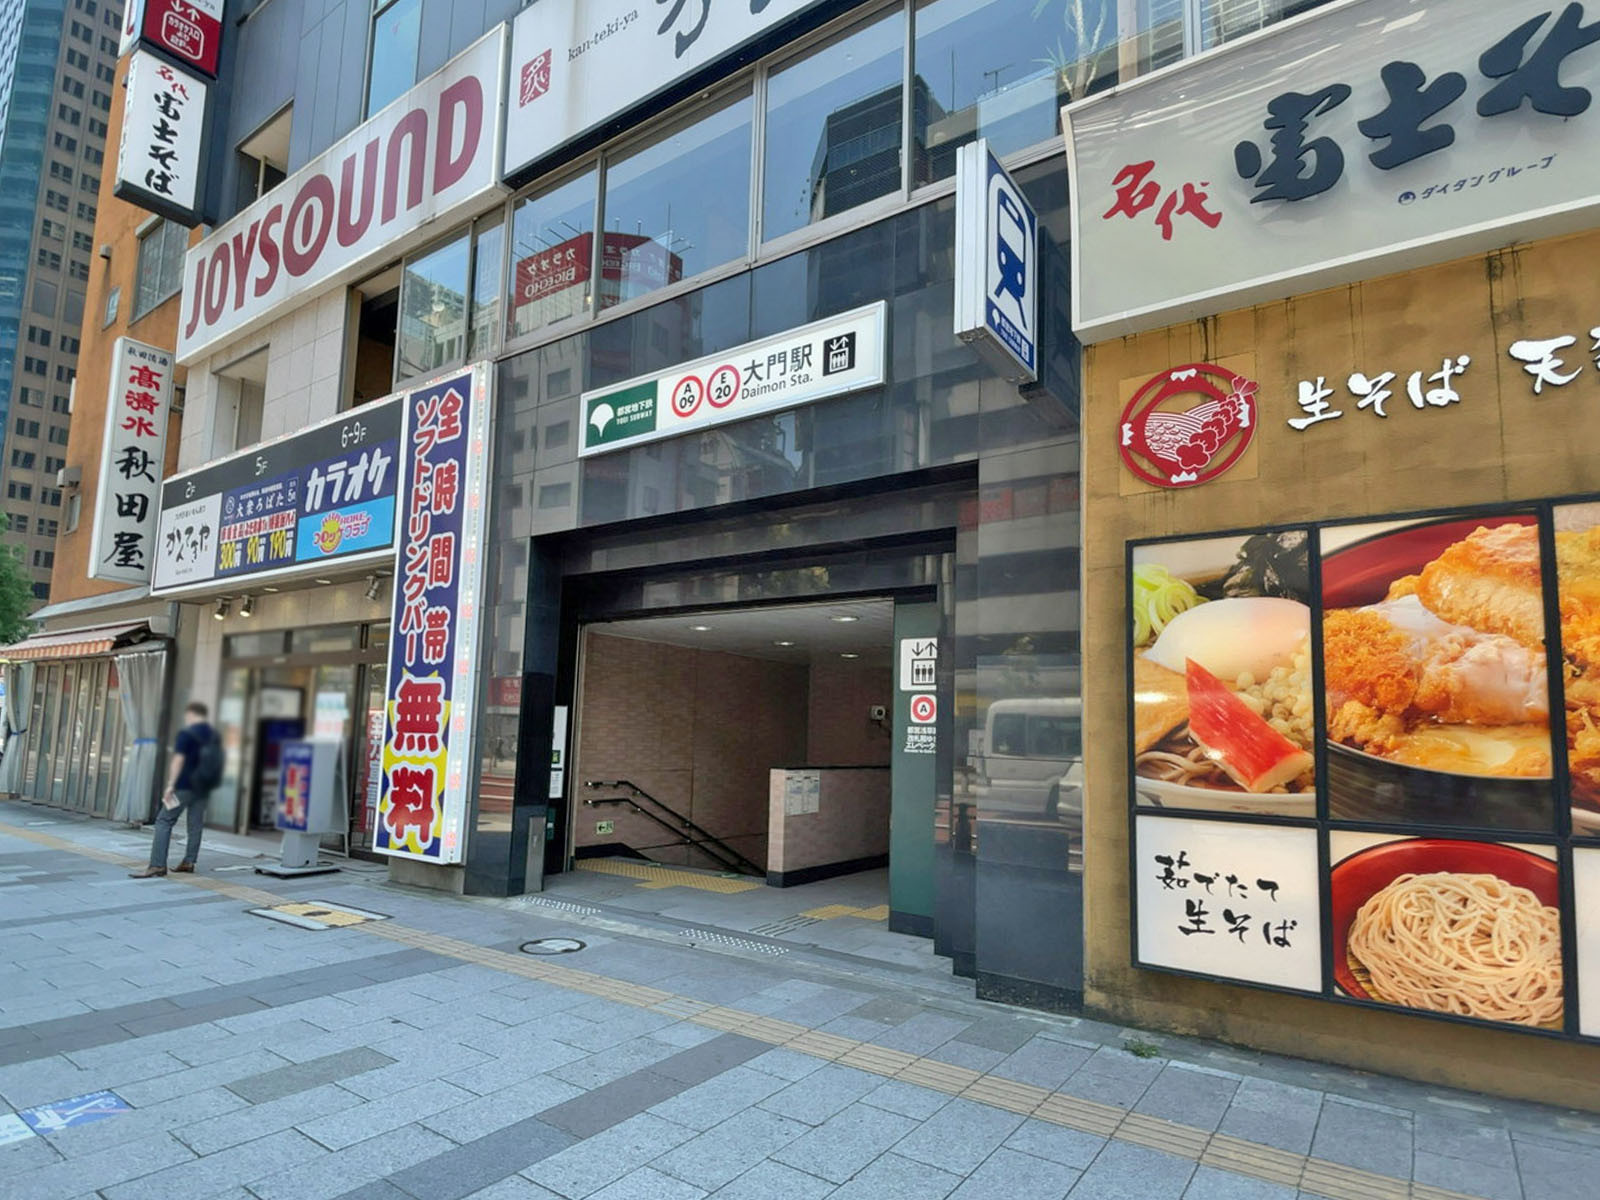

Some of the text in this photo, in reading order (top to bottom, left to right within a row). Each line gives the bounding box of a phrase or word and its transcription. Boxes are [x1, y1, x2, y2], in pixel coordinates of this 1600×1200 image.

[567, 8, 639, 62] kan-teki-ya
[155, 65, 190, 100] 名代
[1103, 160, 1223, 241] 名代
[1420, 153, 1558, 200] ダイタングループ
[185, 75, 484, 340] JOYSOUND
[720, 372, 728, 384] E
[743, 343, 813, 386] 大門駅
[1508, 326, 1600, 394] 天
[679, 395, 696, 409] 09
[683, 382, 693, 395] A
[715, 385, 731, 400] 20
[741, 373, 813, 401] Daimon Sta.
[1287, 354, 1472, 431] 生そば
[341, 421, 367, 449] 6-9F
[255, 455, 268, 477] 5F
[304, 447, 392, 513] カラオケ
[103, 446, 156, 571] 秋田屋
[400, 397, 437, 666] ソフトドリンクバー
[423, 389, 461, 663] 全時間帯
[919, 704, 928, 713] A
[387, 677, 443, 843] 無料
[1154, 851, 1280, 902] 茹でたて
[1177, 899, 1298, 948] 生そば
